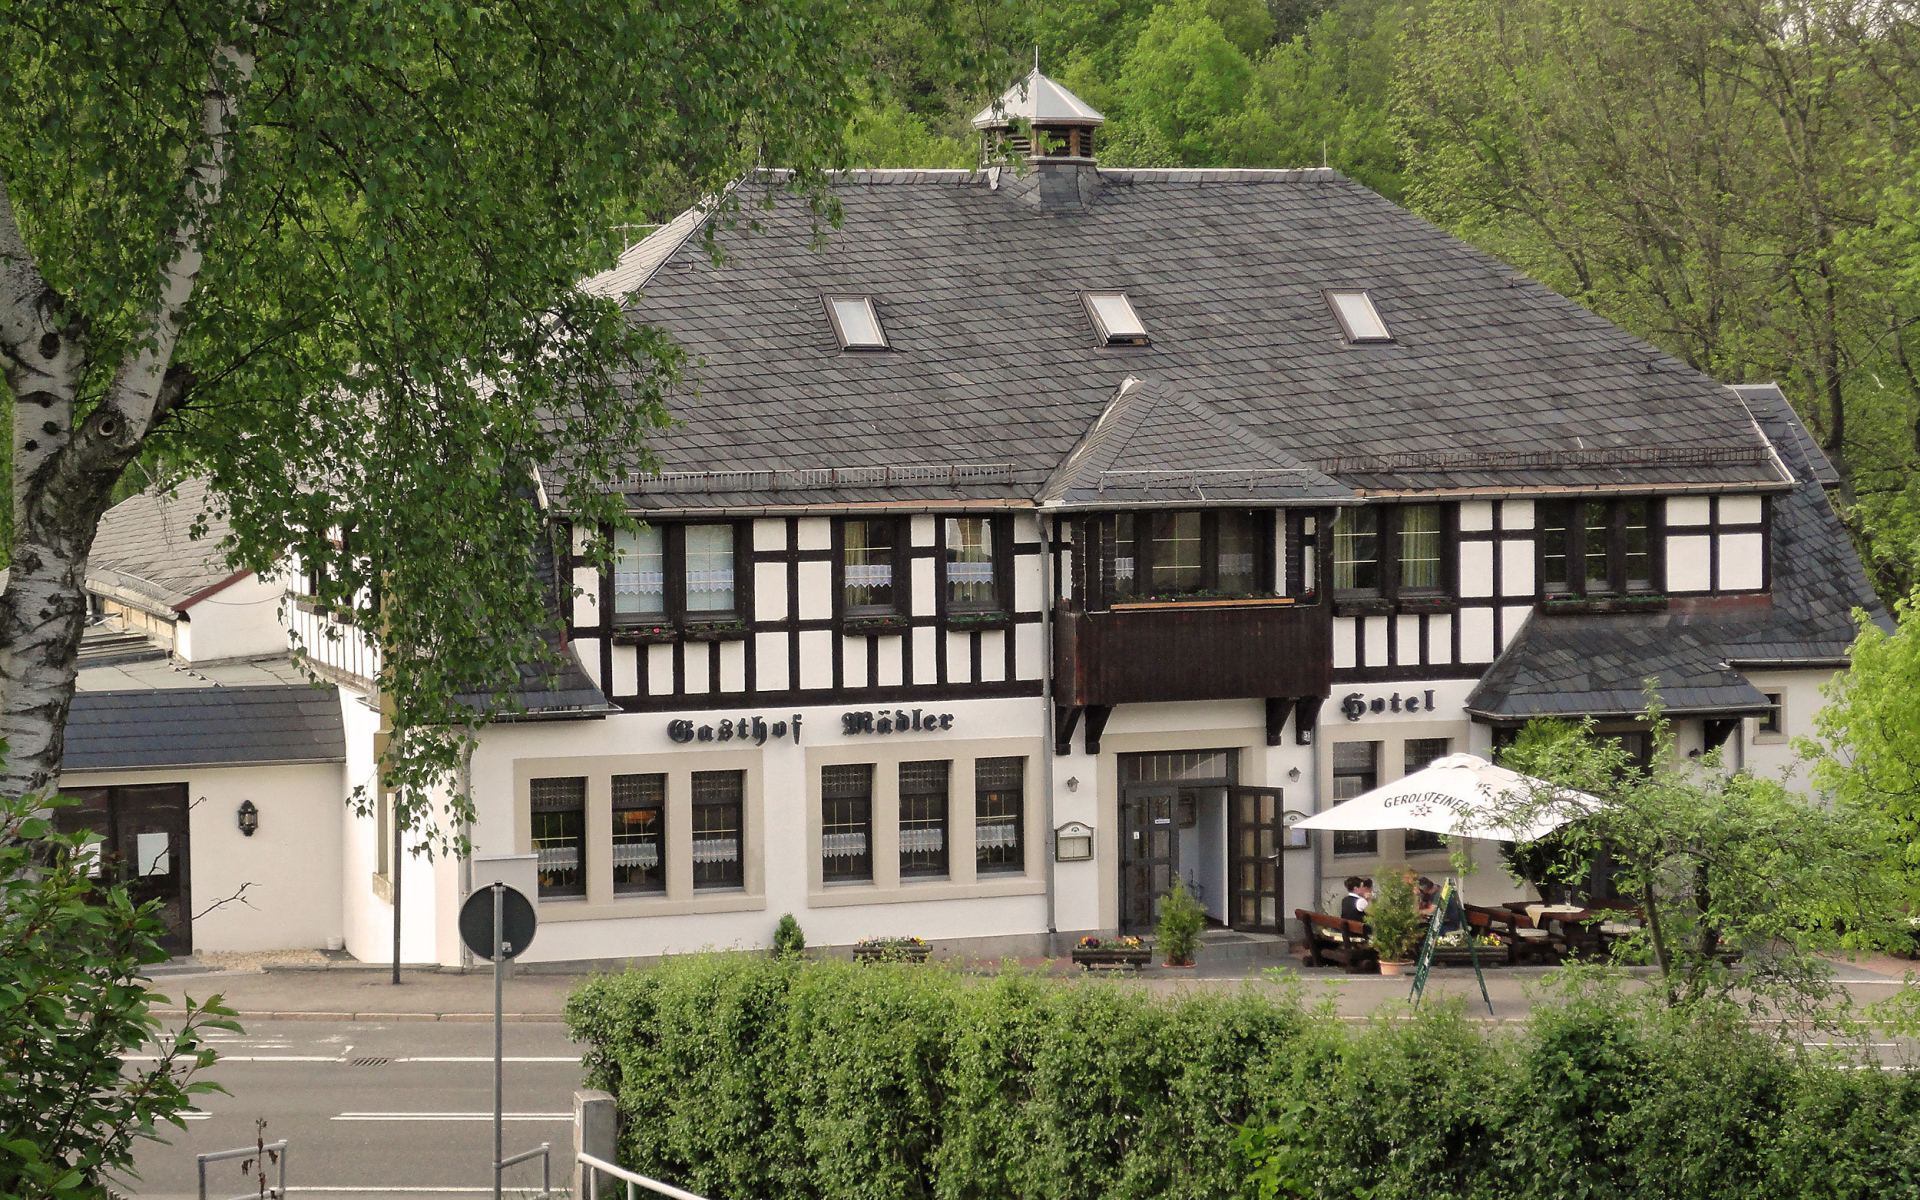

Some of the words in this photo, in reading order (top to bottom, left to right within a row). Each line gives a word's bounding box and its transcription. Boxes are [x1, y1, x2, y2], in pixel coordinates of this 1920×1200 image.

[667, 714, 803, 747] Gasthof
[841, 708, 955, 735] Mädler
[1341, 689, 1436, 722] Hotel
